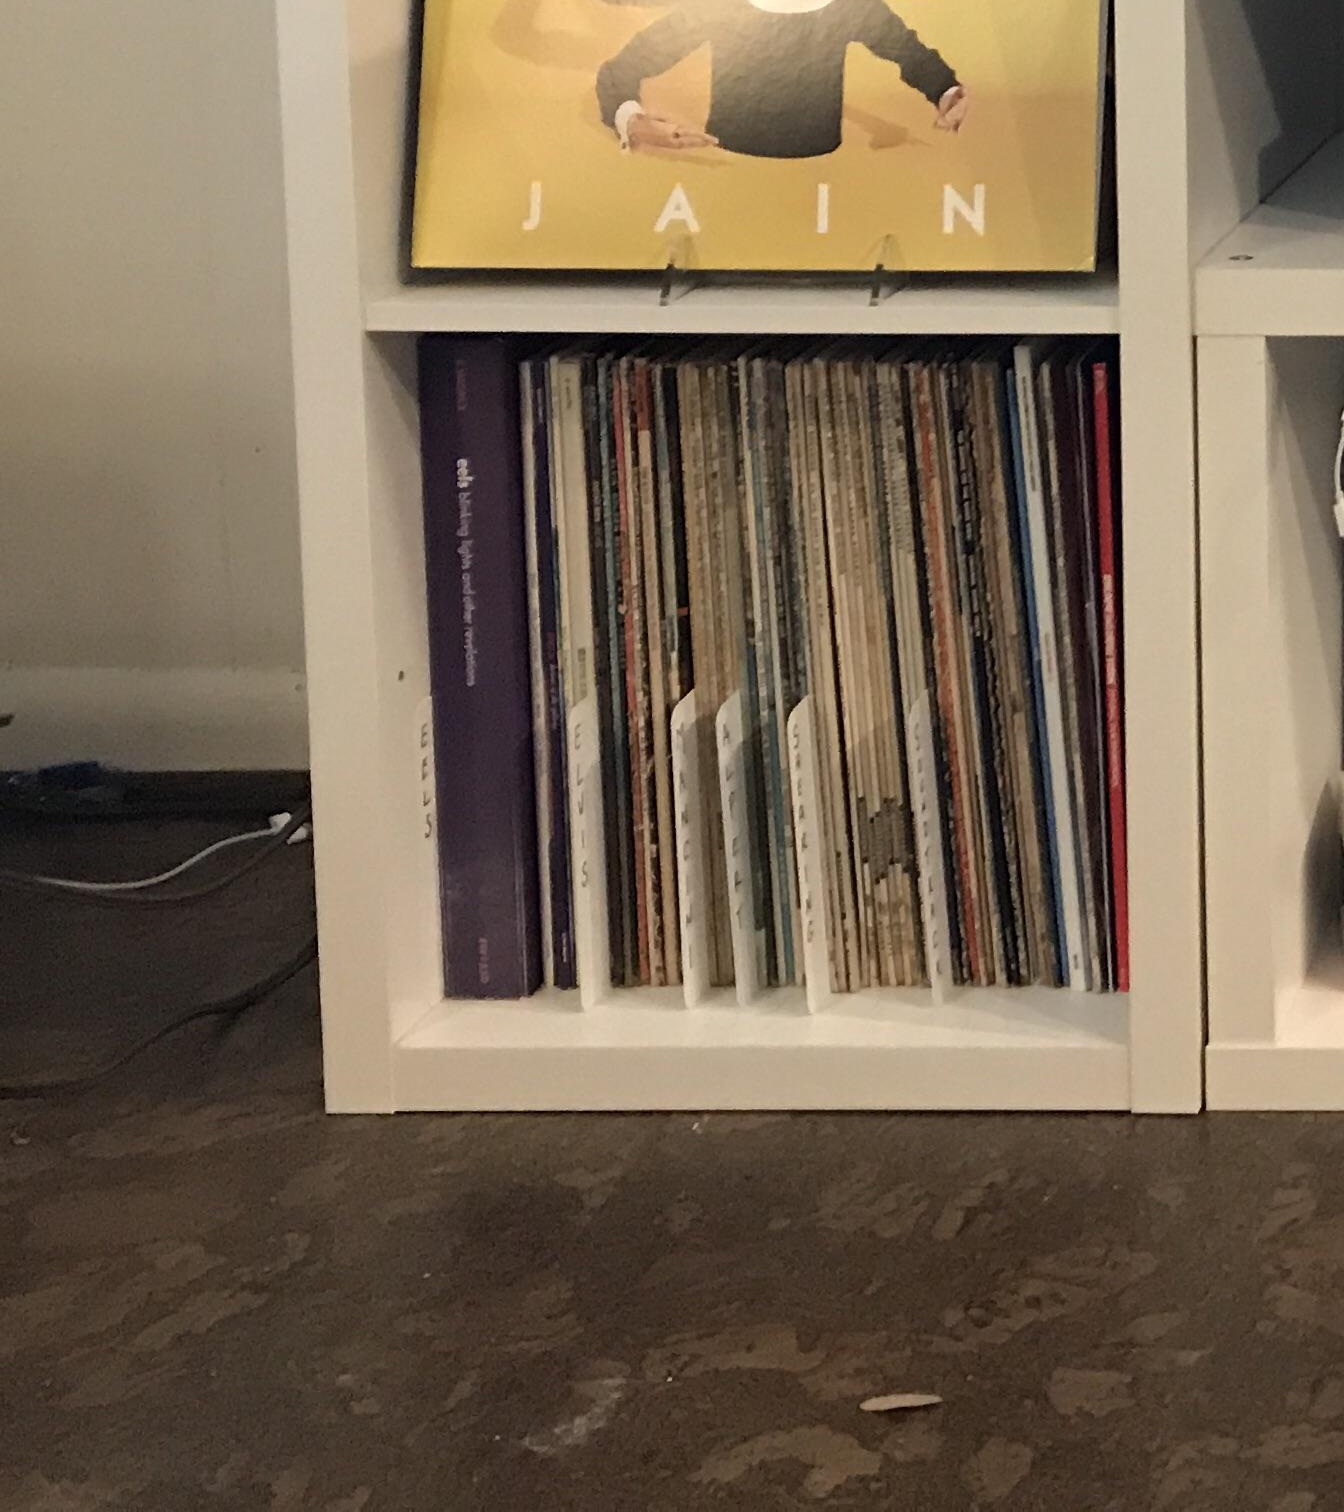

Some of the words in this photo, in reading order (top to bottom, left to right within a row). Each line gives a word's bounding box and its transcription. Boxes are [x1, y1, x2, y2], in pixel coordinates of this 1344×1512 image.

[522, 180, 986, 235] JAIN
[455, 458, 473, 488] eels
[455, 492, 472, 536] blinking
[457, 539, 474, 569] lights
[461, 572, 475, 594] and
[461, 595, 475, 624] other
[574, 722, 589, 888] ELVIS
